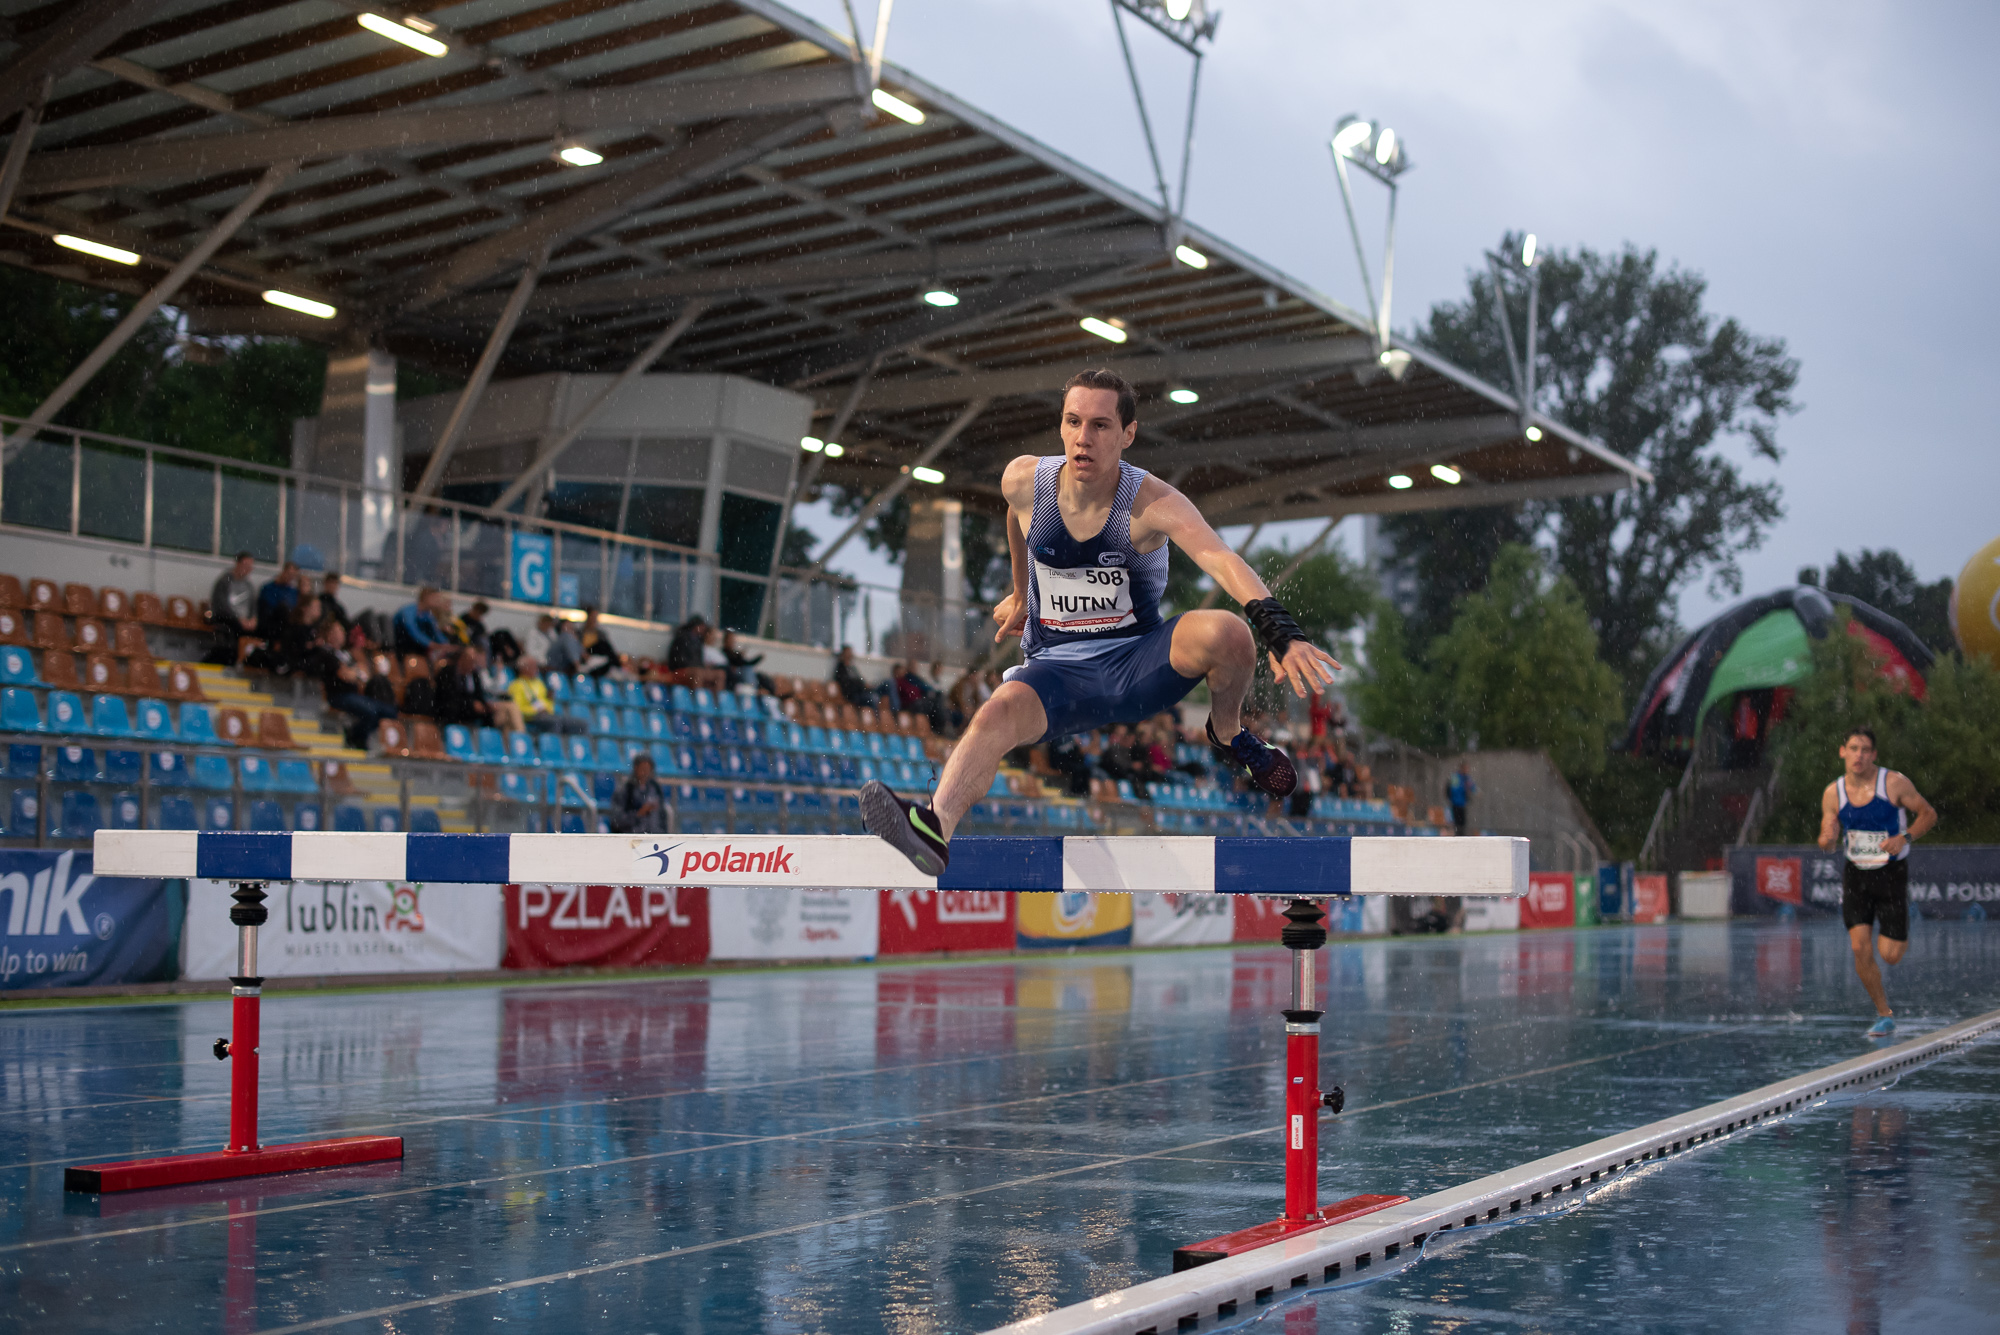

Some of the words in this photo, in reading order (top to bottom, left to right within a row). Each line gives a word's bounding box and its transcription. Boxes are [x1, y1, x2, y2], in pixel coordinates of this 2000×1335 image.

[518, 551, 545, 598] G
[1085, 569, 1124, 586] 508
[1050, 594, 1118, 613] HUTNY
[680, 844, 794, 879] polanik
[518, 884, 692, 930] PZLA.PL
[25, 949, 48, 974] to
[52, 945, 88, 972] win
